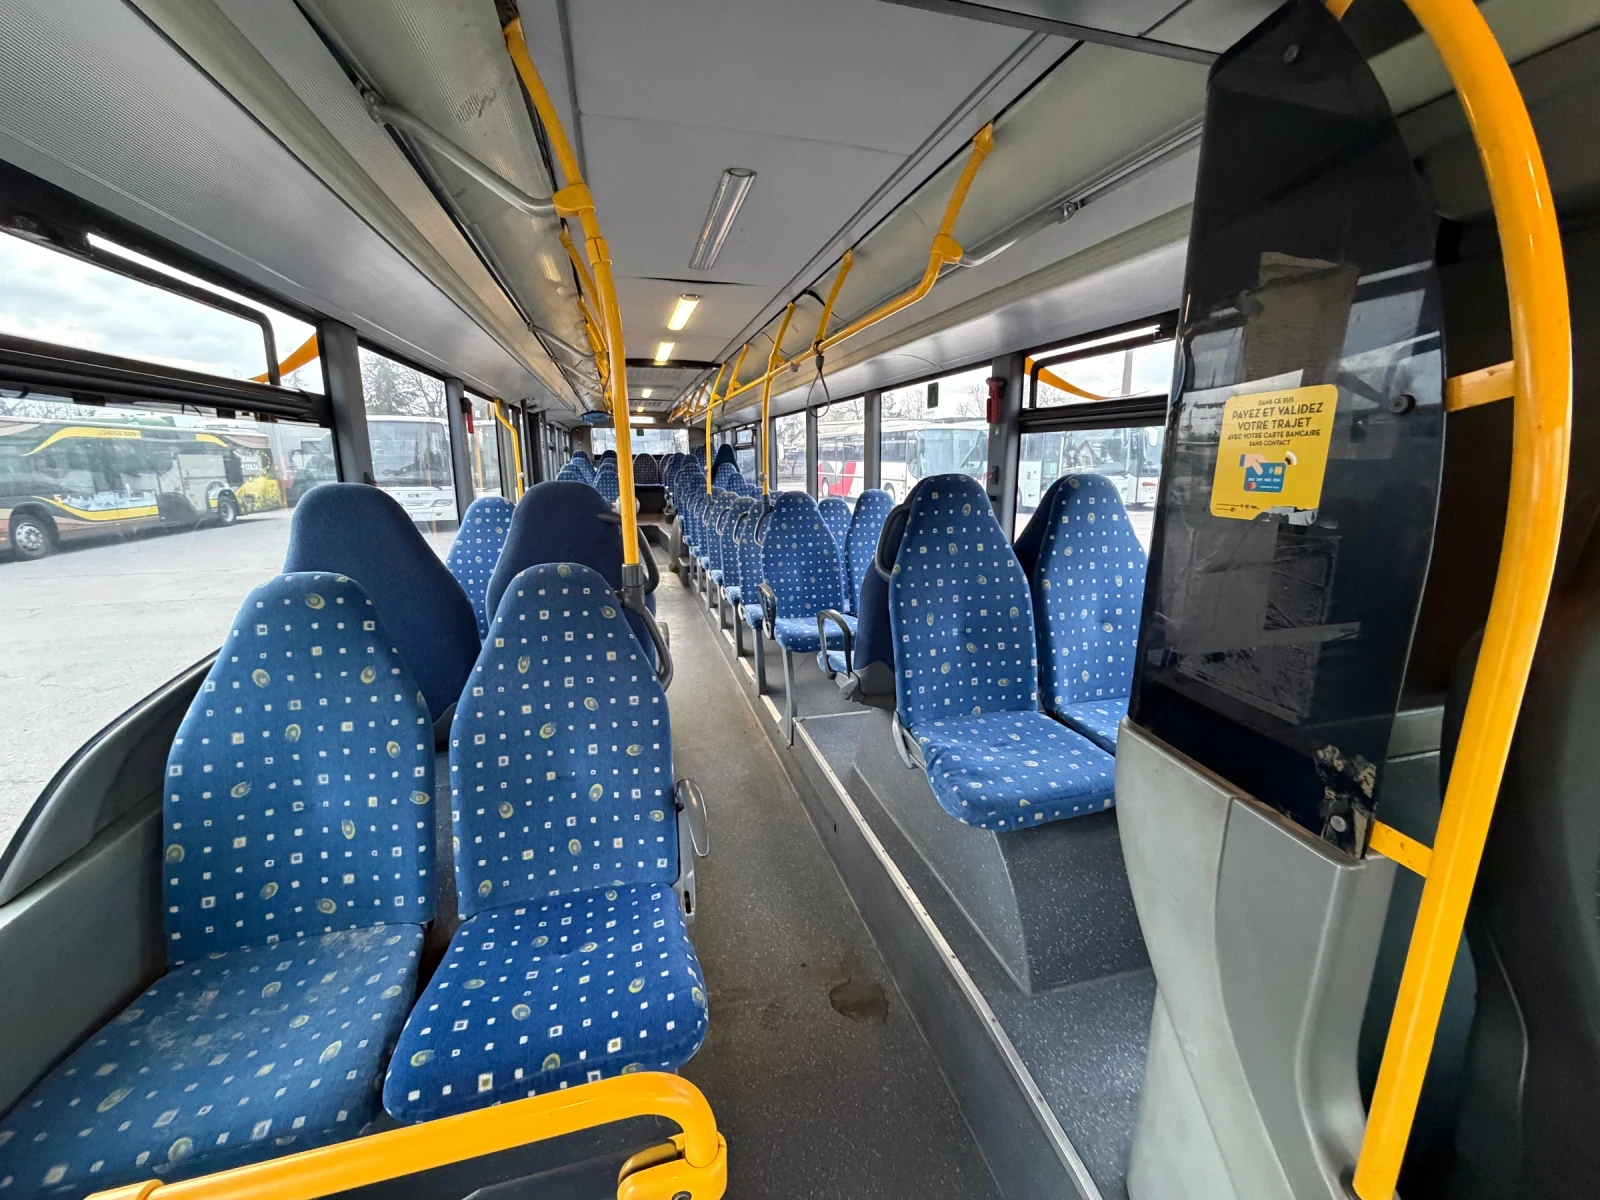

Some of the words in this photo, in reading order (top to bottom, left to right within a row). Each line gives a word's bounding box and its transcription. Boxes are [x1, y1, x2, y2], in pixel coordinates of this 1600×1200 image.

[1232, 408, 1261, 420] PAYEZ
[1262, 406, 1276, 417] ET
[1278, 402, 1324, 416] VALIDEZ
[1238, 420, 1269, 431] VOTRE
[1271, 417, 1312, 430] TRAJET
[1243, 432, 1262, 440] VOTRE
[1263, 431, 1284, 439] CARTE
[1285, 429, 1321, 438] BANCAIRE
